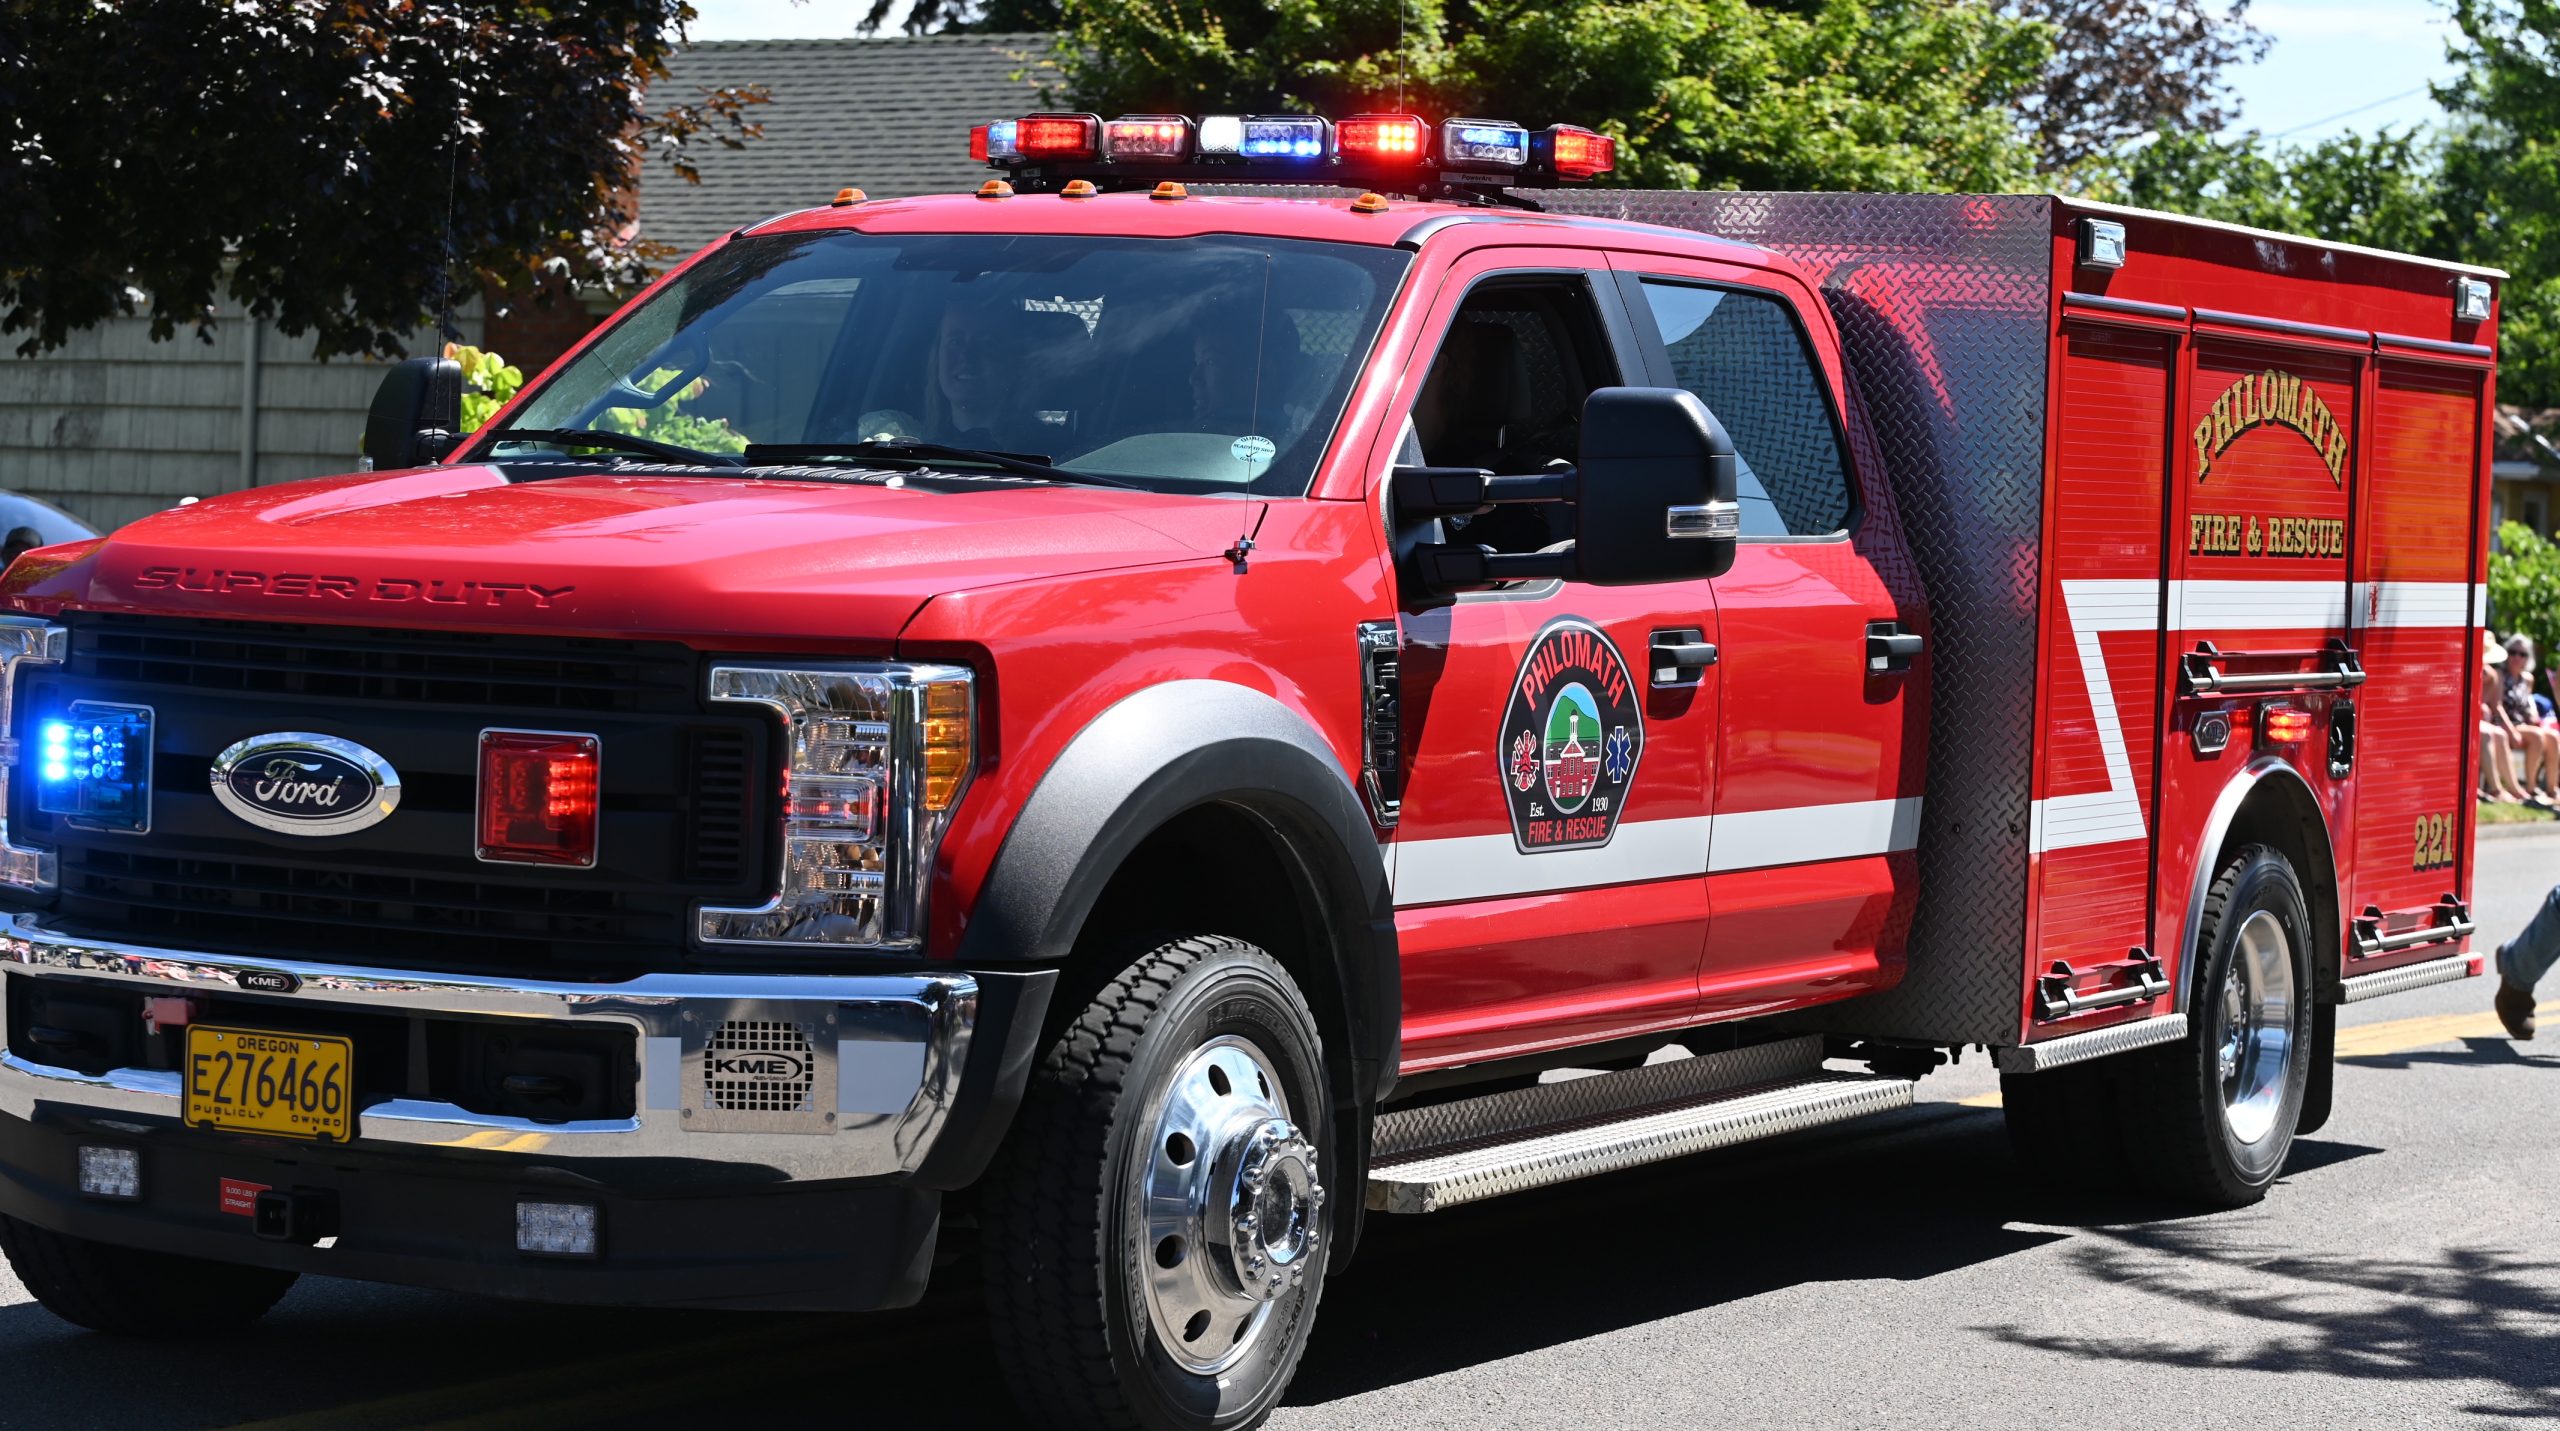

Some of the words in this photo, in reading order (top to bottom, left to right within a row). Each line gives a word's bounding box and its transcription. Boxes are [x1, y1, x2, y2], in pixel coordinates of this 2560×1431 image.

[2194, 369, 2348, 488] PHILOMATH
[2190, 514, 2242, 555] FIRE
[2247, 515, 2263, 556] &
[2267, 517, 2344, 558] RESCUE
[134, 566, 360, 599] SUPER
[369, 578, 576, 608] DUTY
[1522, 630, 1626, 711] PHILOMATH
[255, 758, 343, 806] Ford
[1529, 802, 1545, 818] Est.
[1591, 797, 1609, 812] 1930
[1527, 820, 1552, 844] FIRE
[1554, 818, 1563, 841] &
[1565, 815, 1606, 840] RESCUE
[2413, 812, 2453, 869] 221
[247, 976, 282, 987] KME
[237, 1036, 300, 1054] OREGON
[192, 1050, 341, 1115] E276466
[715, 1059, 788, 1075] KME
[193, 1104, 265, 1119] PUBLICLY
[291, 1114, 342, 1127] OWNED
